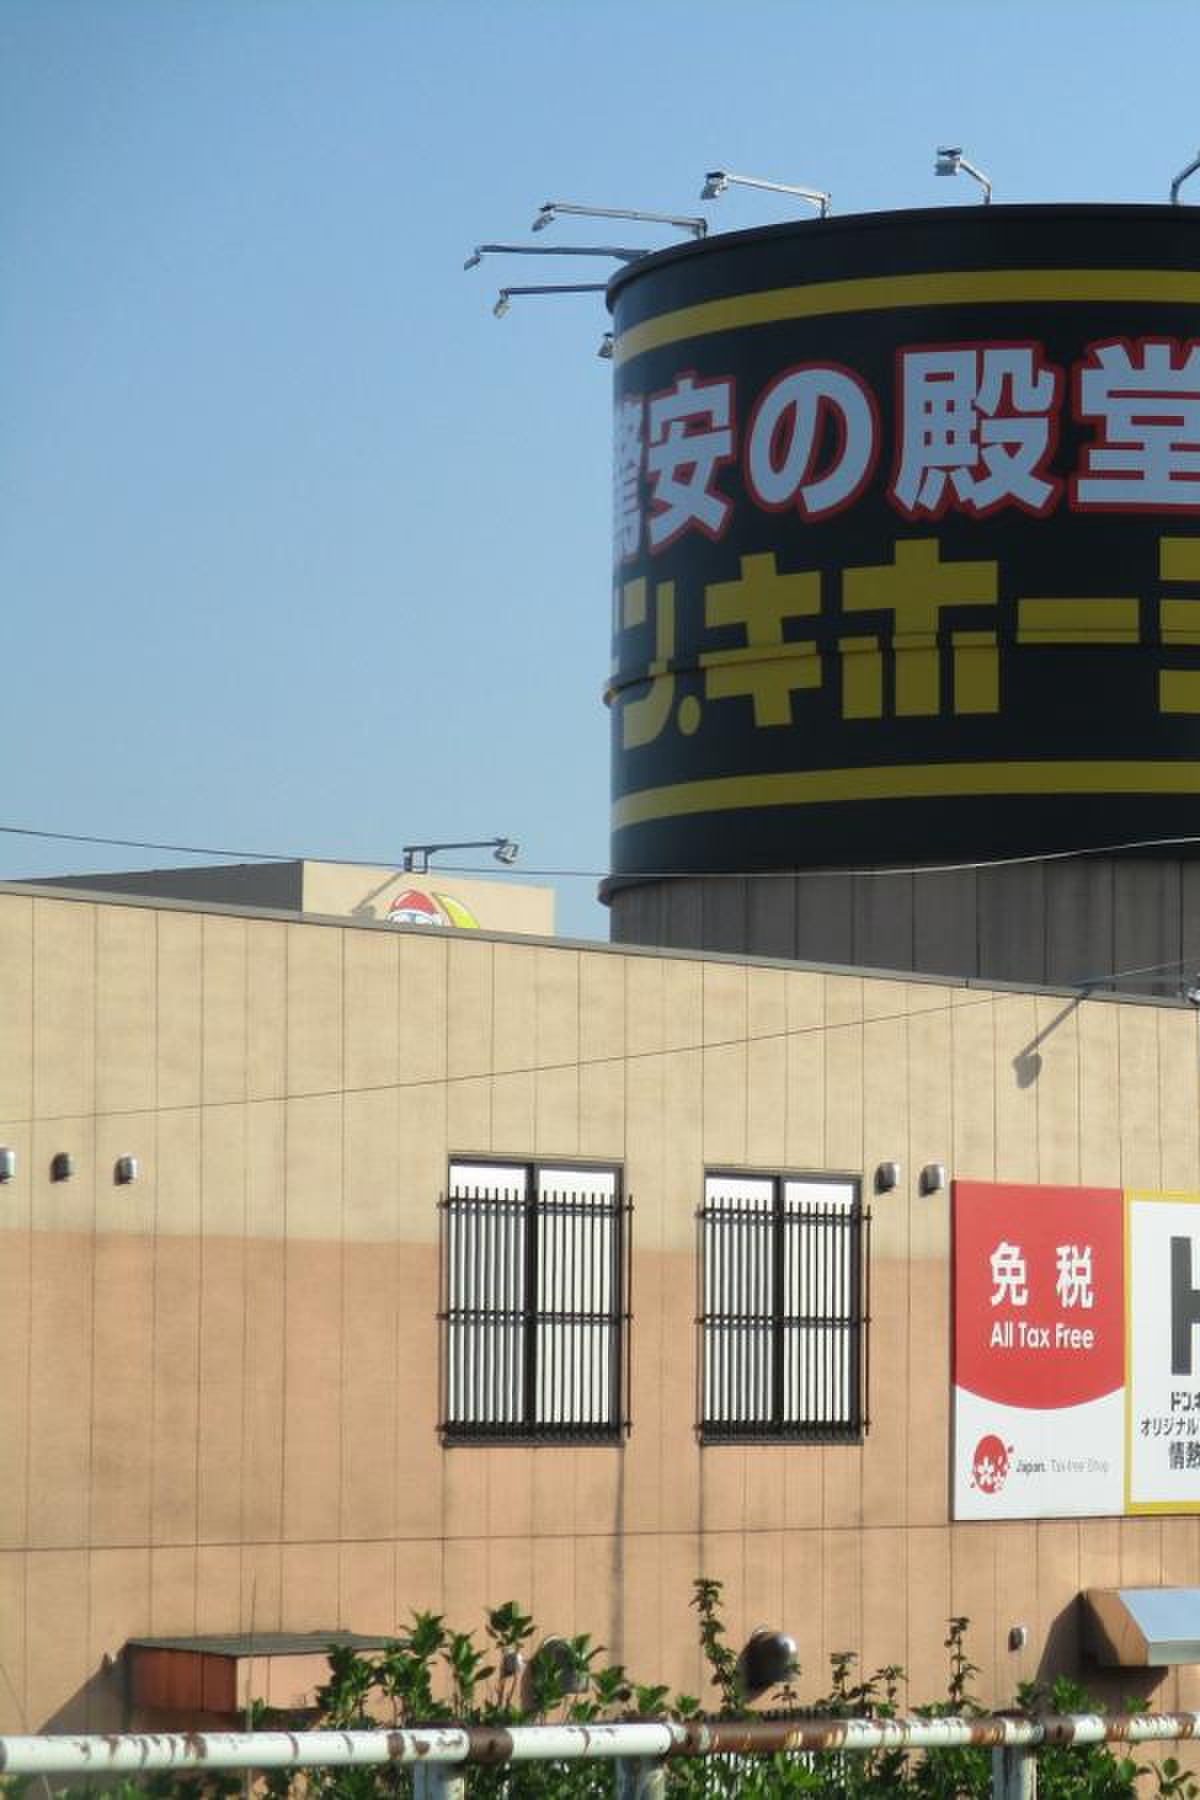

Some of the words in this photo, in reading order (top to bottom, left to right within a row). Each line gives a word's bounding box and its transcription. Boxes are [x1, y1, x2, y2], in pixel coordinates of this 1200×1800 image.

[989, 1241, 1093, 1308] 免税
[990, 1321, 1013, 1348] All
[1018, 1321, 1050, 1348] Tax
[1055, 1322, 1094, 1349] Free
